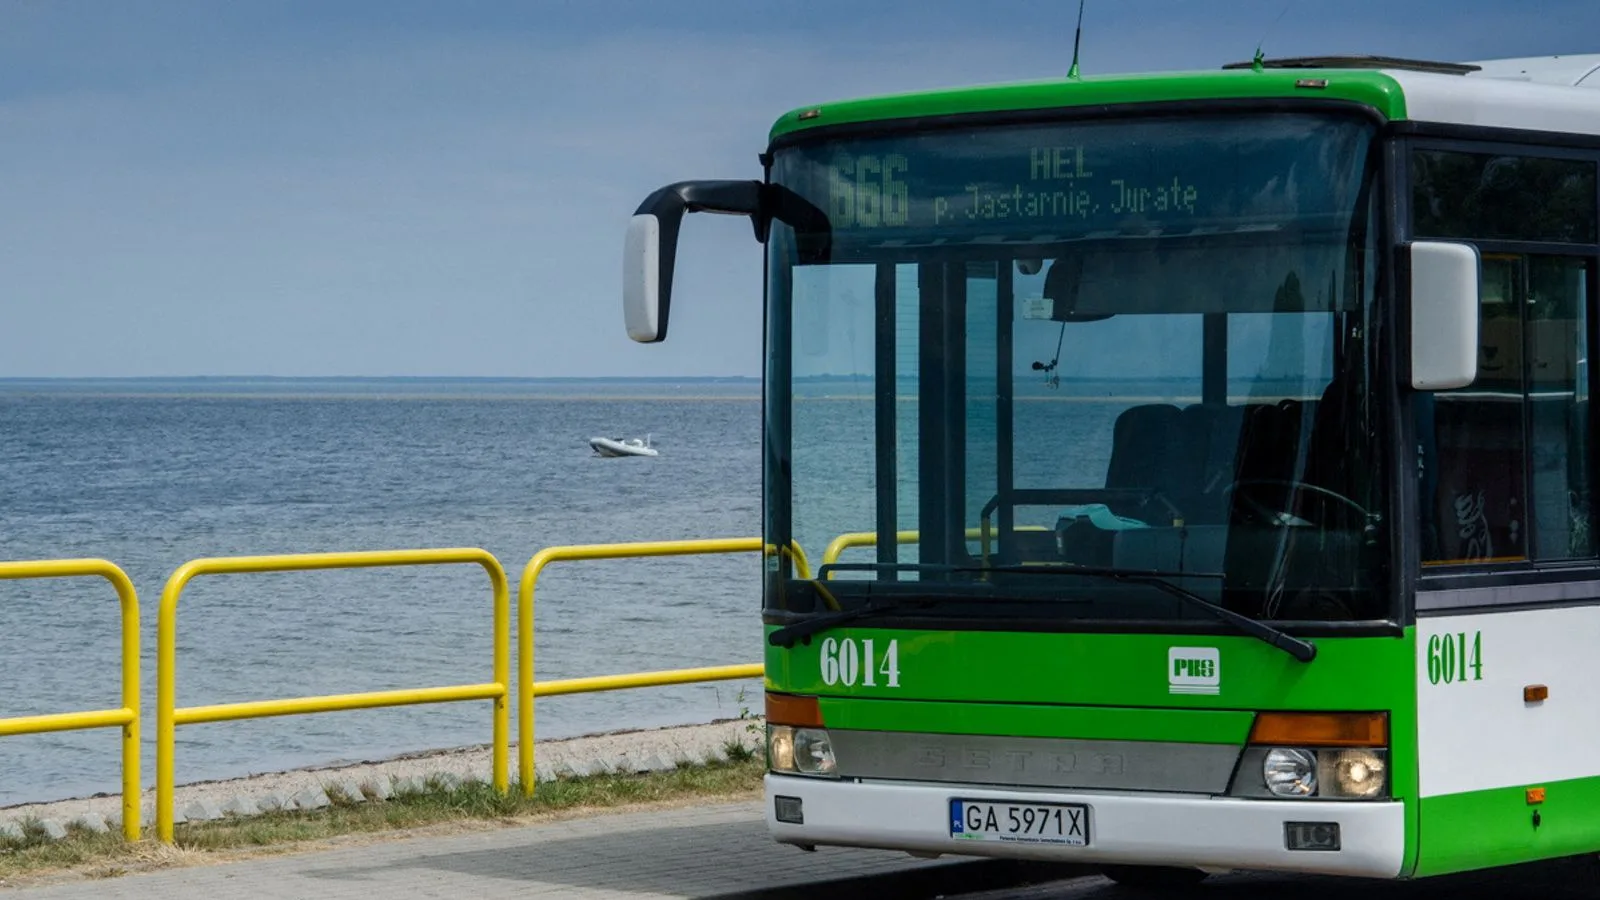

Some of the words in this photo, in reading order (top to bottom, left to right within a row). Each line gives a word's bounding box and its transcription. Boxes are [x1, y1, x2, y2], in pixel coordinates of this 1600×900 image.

[1030, 146, 1093, 180] HEL
[829, 153, 908, 228] 666
[934, 196, 955, 225] p.
[964, 181, 1100, 219] Jastarnię,
[1110, 175, 1198, 215] Juratę
[820, 637, 901, 689] 6014
[1174, 658, 1215, 678] PKS
[1427, 630, 1483, 685] 6014
[915, 746, 1126, 775] SETRA
[966, 805, 1000, 832] GA
[1008, 806, 1082, 836] 5971X
